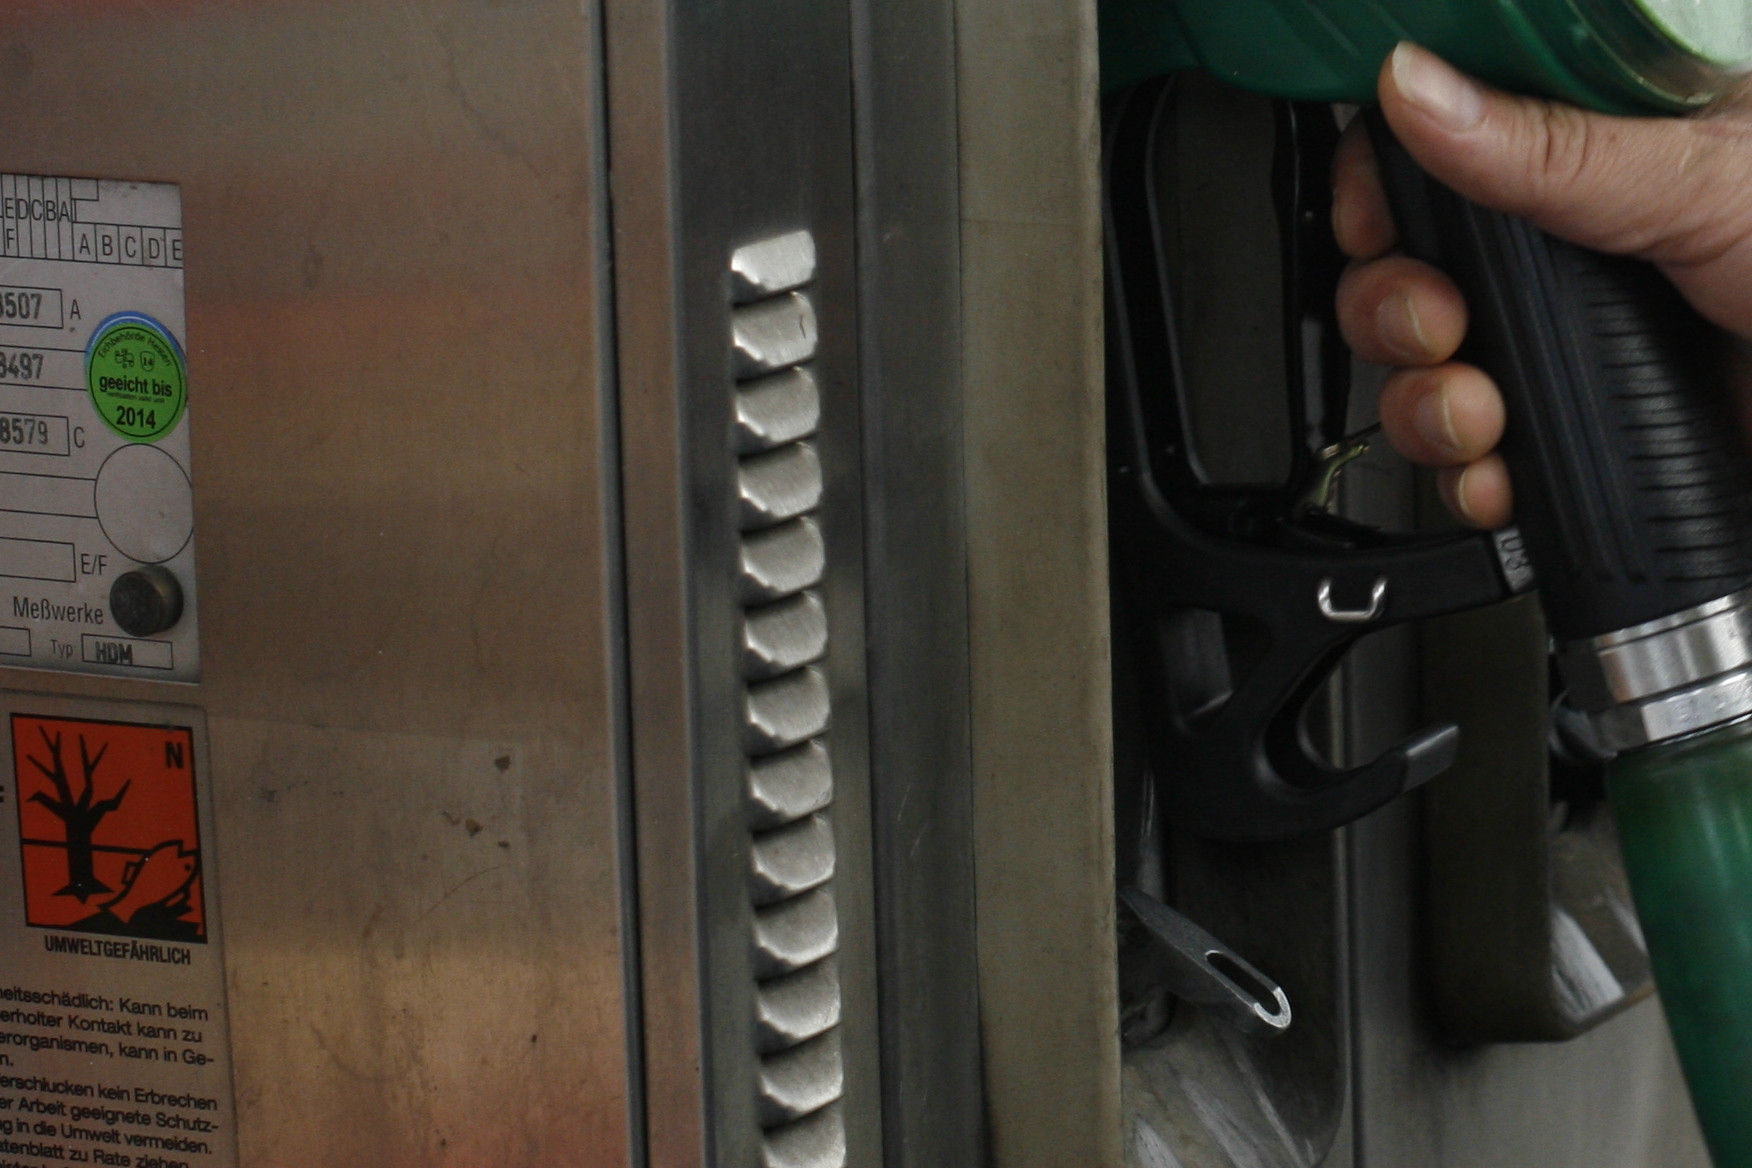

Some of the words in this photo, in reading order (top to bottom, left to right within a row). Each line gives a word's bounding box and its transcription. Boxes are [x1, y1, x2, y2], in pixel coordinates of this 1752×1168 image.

[0, 292, 42, 320] 507
[69, 298, 82, 321] A
[99, 375, 149, 394] geeicht
[152, 378, 173, 398] bis
[116, 405, 157, 430] 2014
[73, 426, 86, 449] C
[80, 553, 108, 576] E/F
[13, 595, 104, 625] Meßwerke
[51, 638, 74, 658] Typ
[44, 934, 192, 965] UMWELTGEFÄHRLICH
[119, 997, 162, 1017] Kann
[166, 1002, 209, 1022] beim
[0, 1008, 63, 1029] erholter
[68, 1014, 133, 1037] Kontakt
[137, 1022, 178, 1041] kann
[182, 1030, 203, 1043] zu
[118, 1042, 159, 1061] kann
[163, 1046, 178, 1063] in
[182, 1048, 215, 1067] Ge-
[98, 1084, 131, 1102] kein
[134, 1087, 218, 1112] Erbrechen
[18, 1096, 67, 1117] Arbeit
[70, 1105, 152, 1127] geeignete
[155, 1112, 219, 1134] Schutz-
[16, 1118, 31, 1135] in
[33, 1120, 57, 1137] die
[61, 1123, 122, 1145] Umwelt
[124, 1133, 213, 1156] vermeiden.
[69, 1149, 89, 1163] zu
[93, 1149, 132, 1167] Rate
